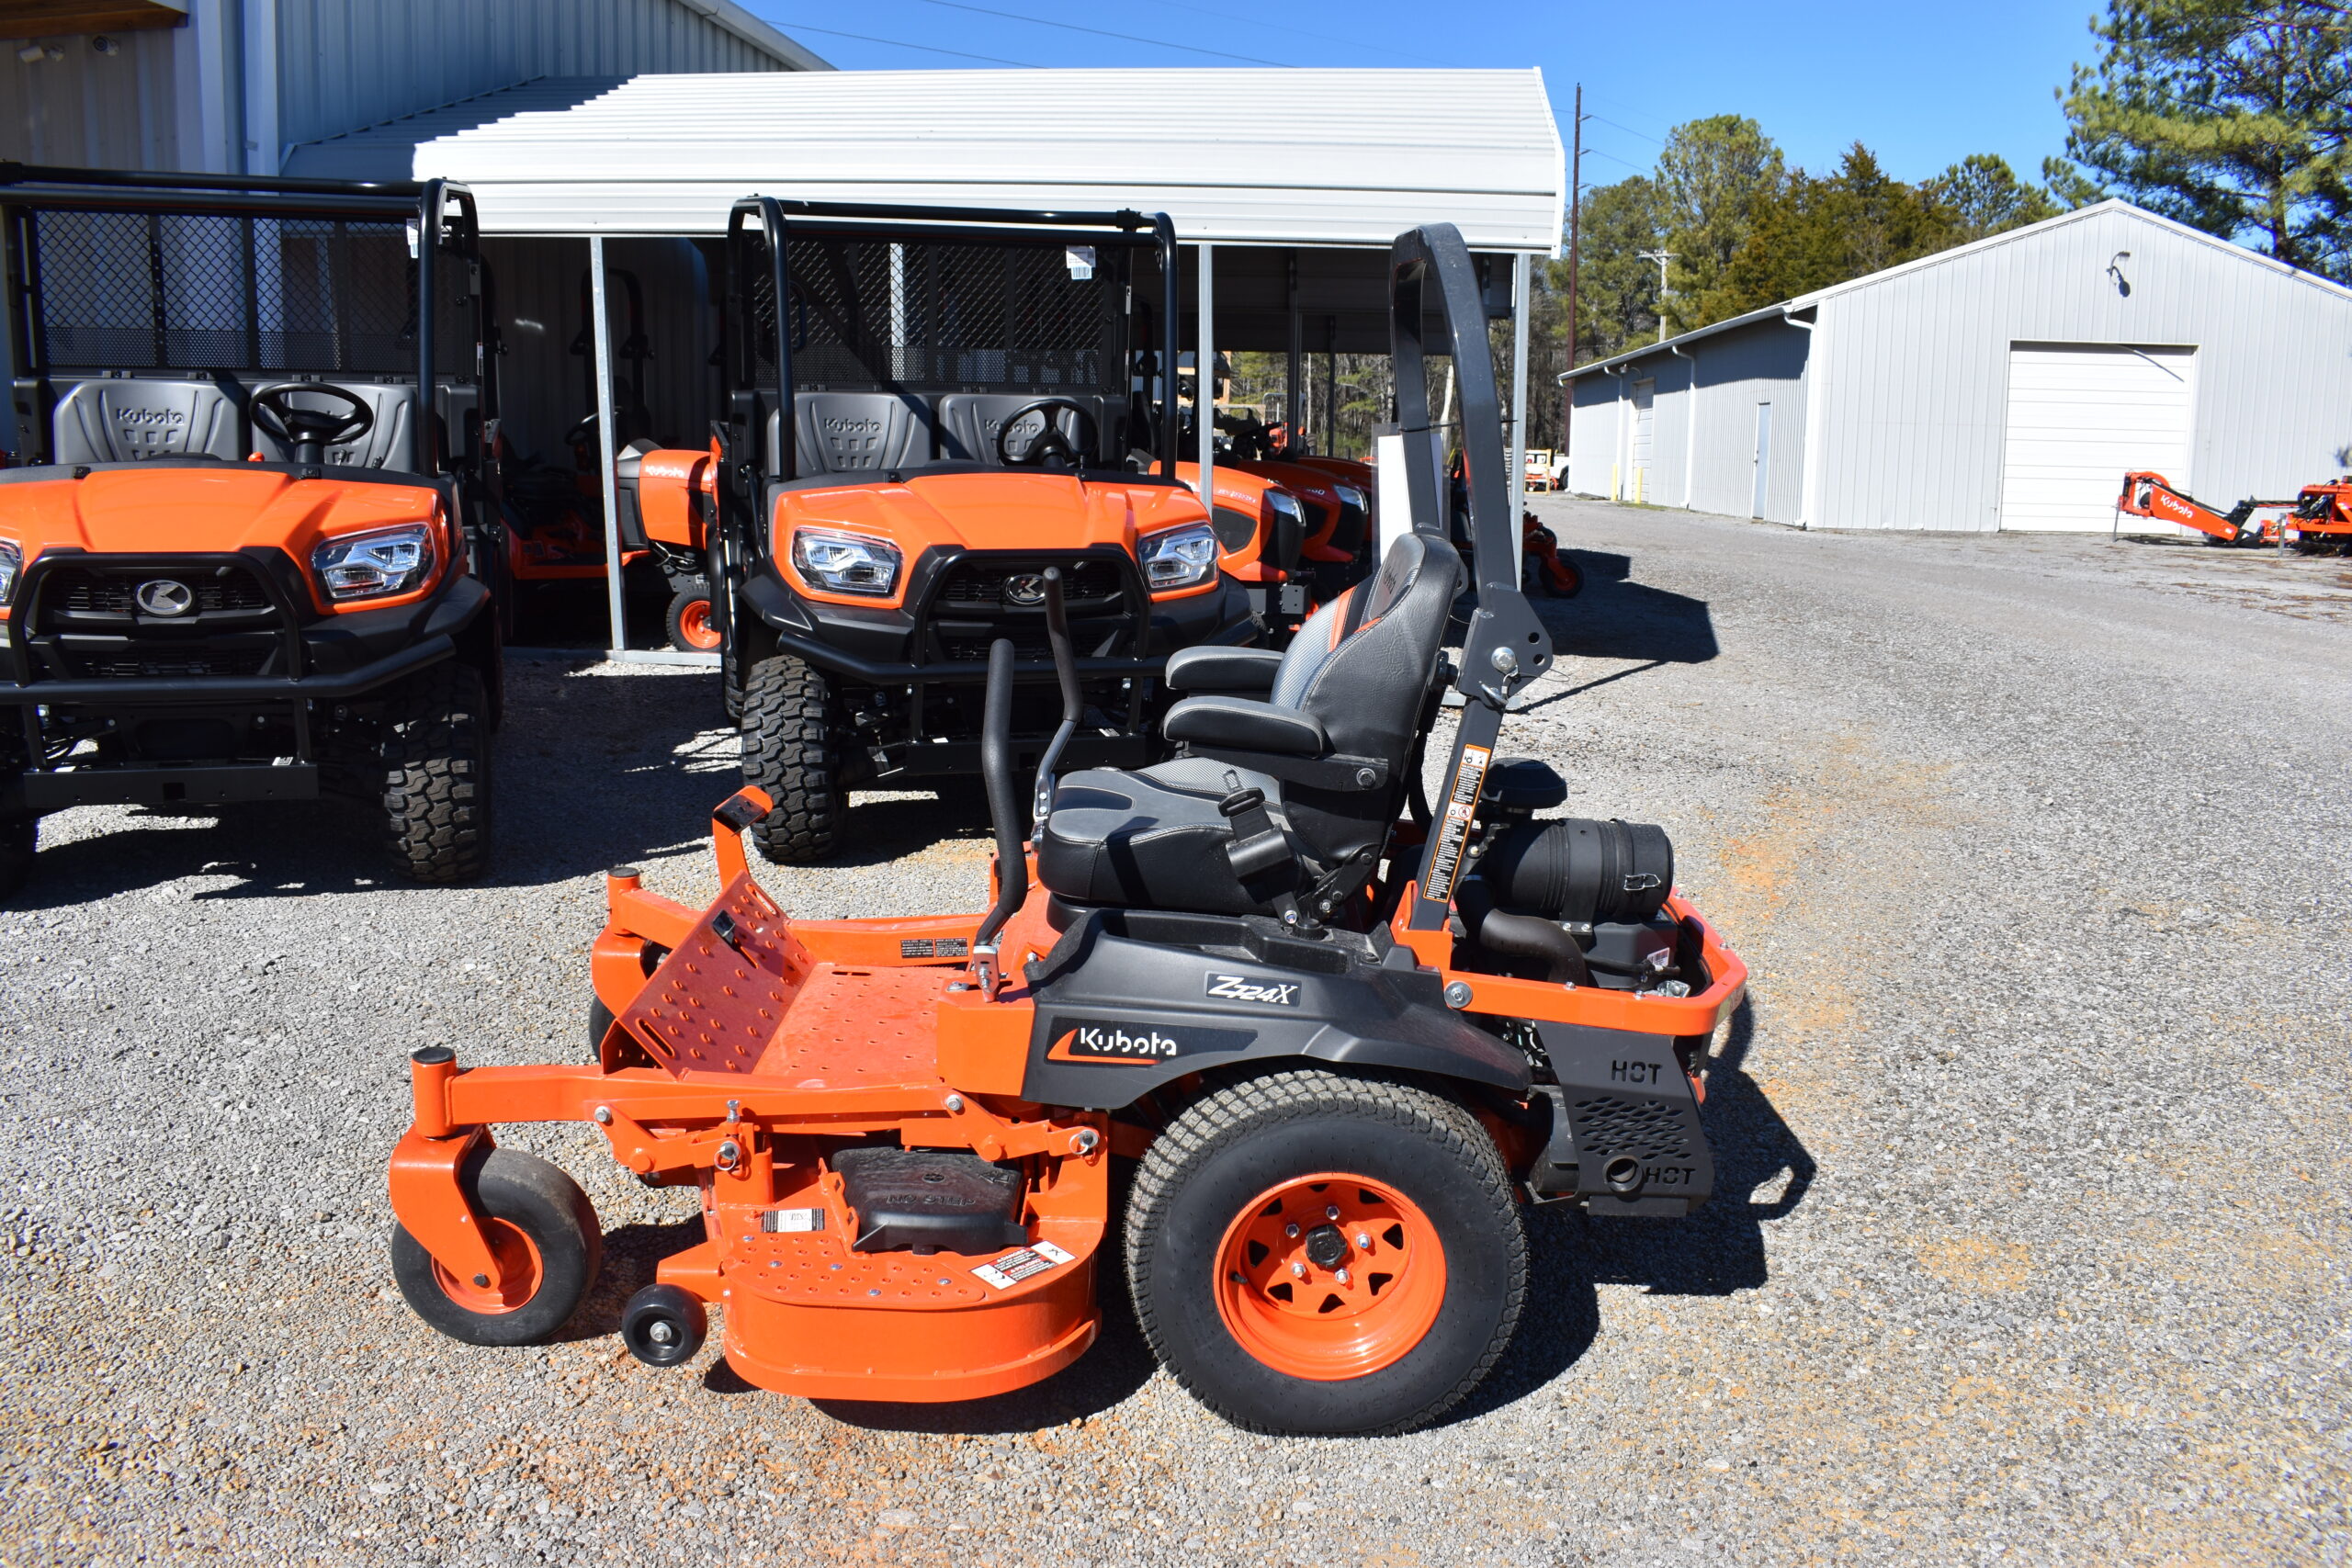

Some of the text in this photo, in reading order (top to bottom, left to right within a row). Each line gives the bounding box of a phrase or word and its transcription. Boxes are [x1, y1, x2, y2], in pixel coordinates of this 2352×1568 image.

[116, 408, 184, 426] Kubota
[824, 418, 883, 434] Kubota
[645, 466, 684, 477] Kubota
[2161, 494, 2194, 518] Kubota
[1208, 976, 1298, 1004] Z724X
[1080, 1027, 1177, 1056] Kubota
[1611, 1059, 1663, 1085] HOT
[1645, 1167, 1696, 1185] HOT
[886, 1194, 976, 1206] NO STEP
